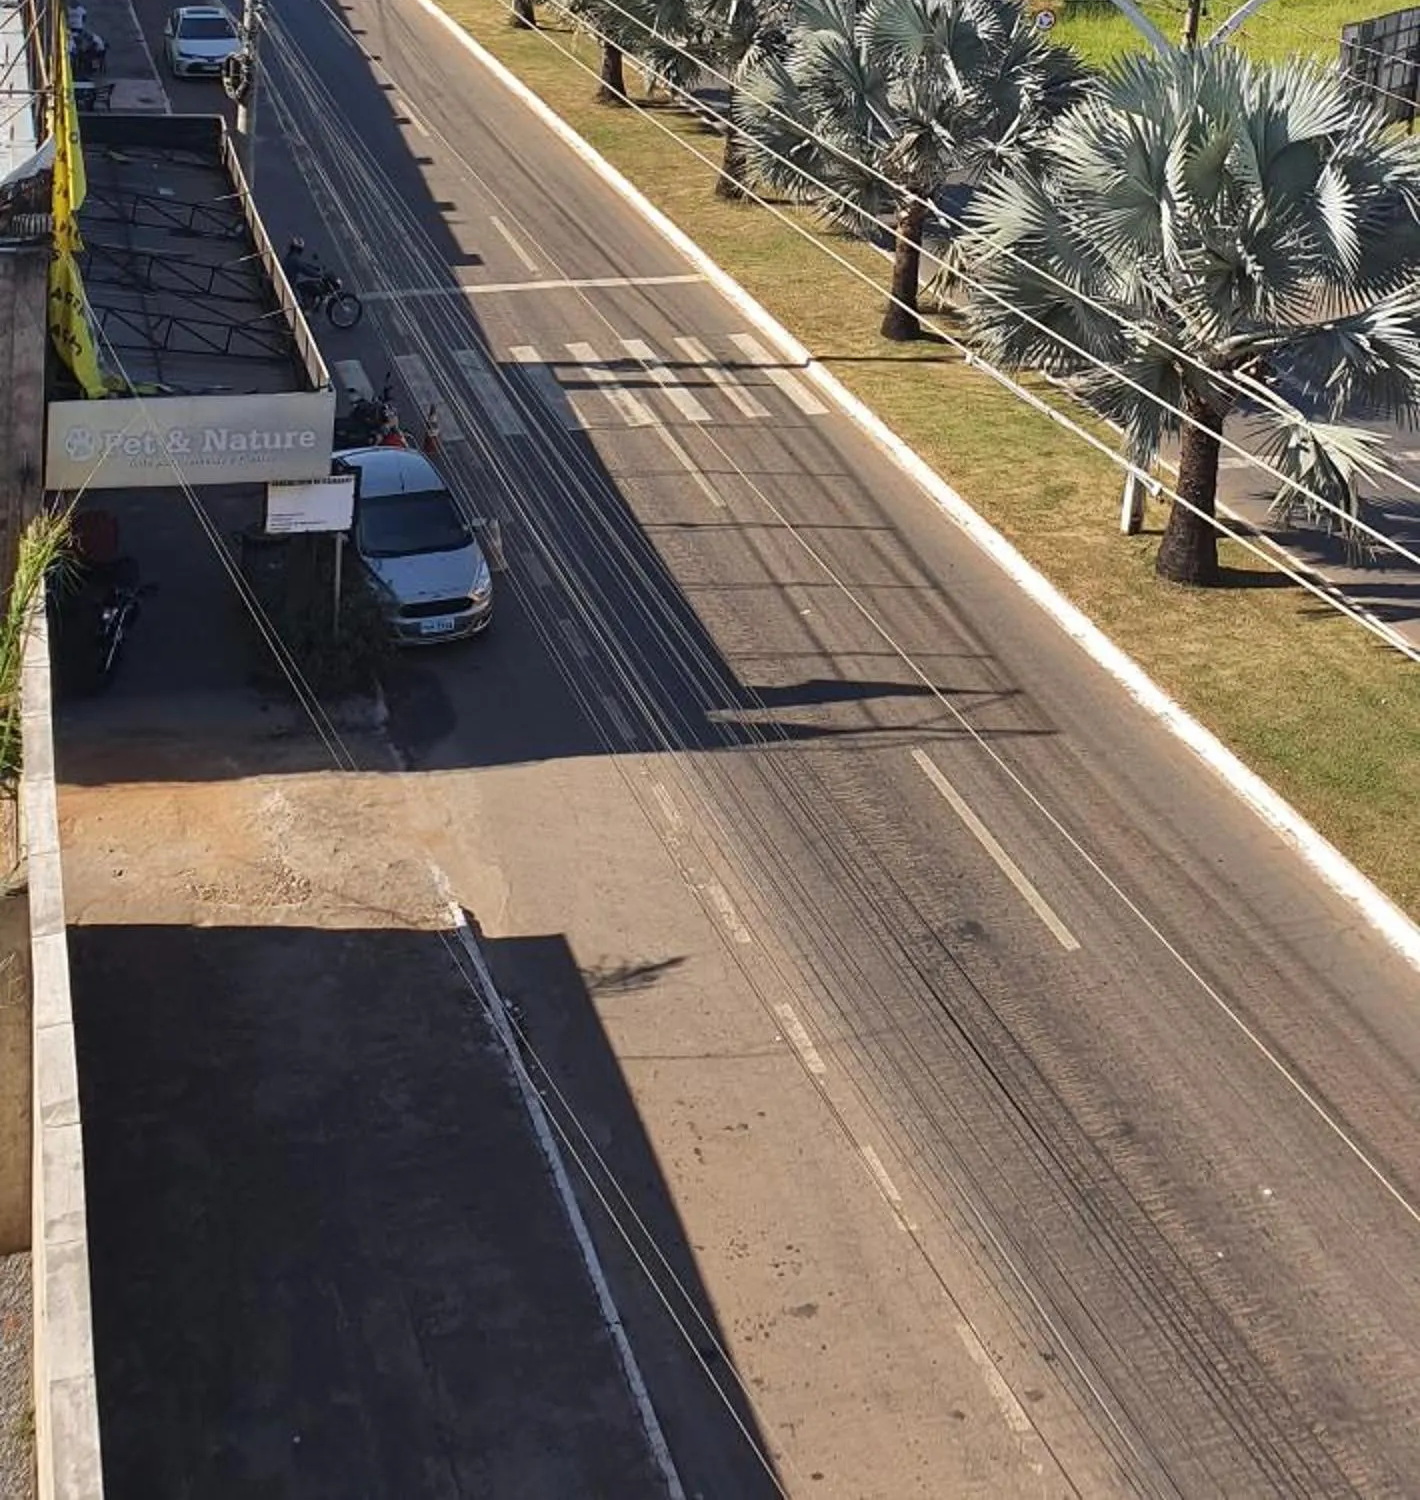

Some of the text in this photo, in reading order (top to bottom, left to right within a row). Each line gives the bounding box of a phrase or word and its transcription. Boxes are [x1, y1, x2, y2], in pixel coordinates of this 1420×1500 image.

[103, 427, 316, 455] Pet & Nature
